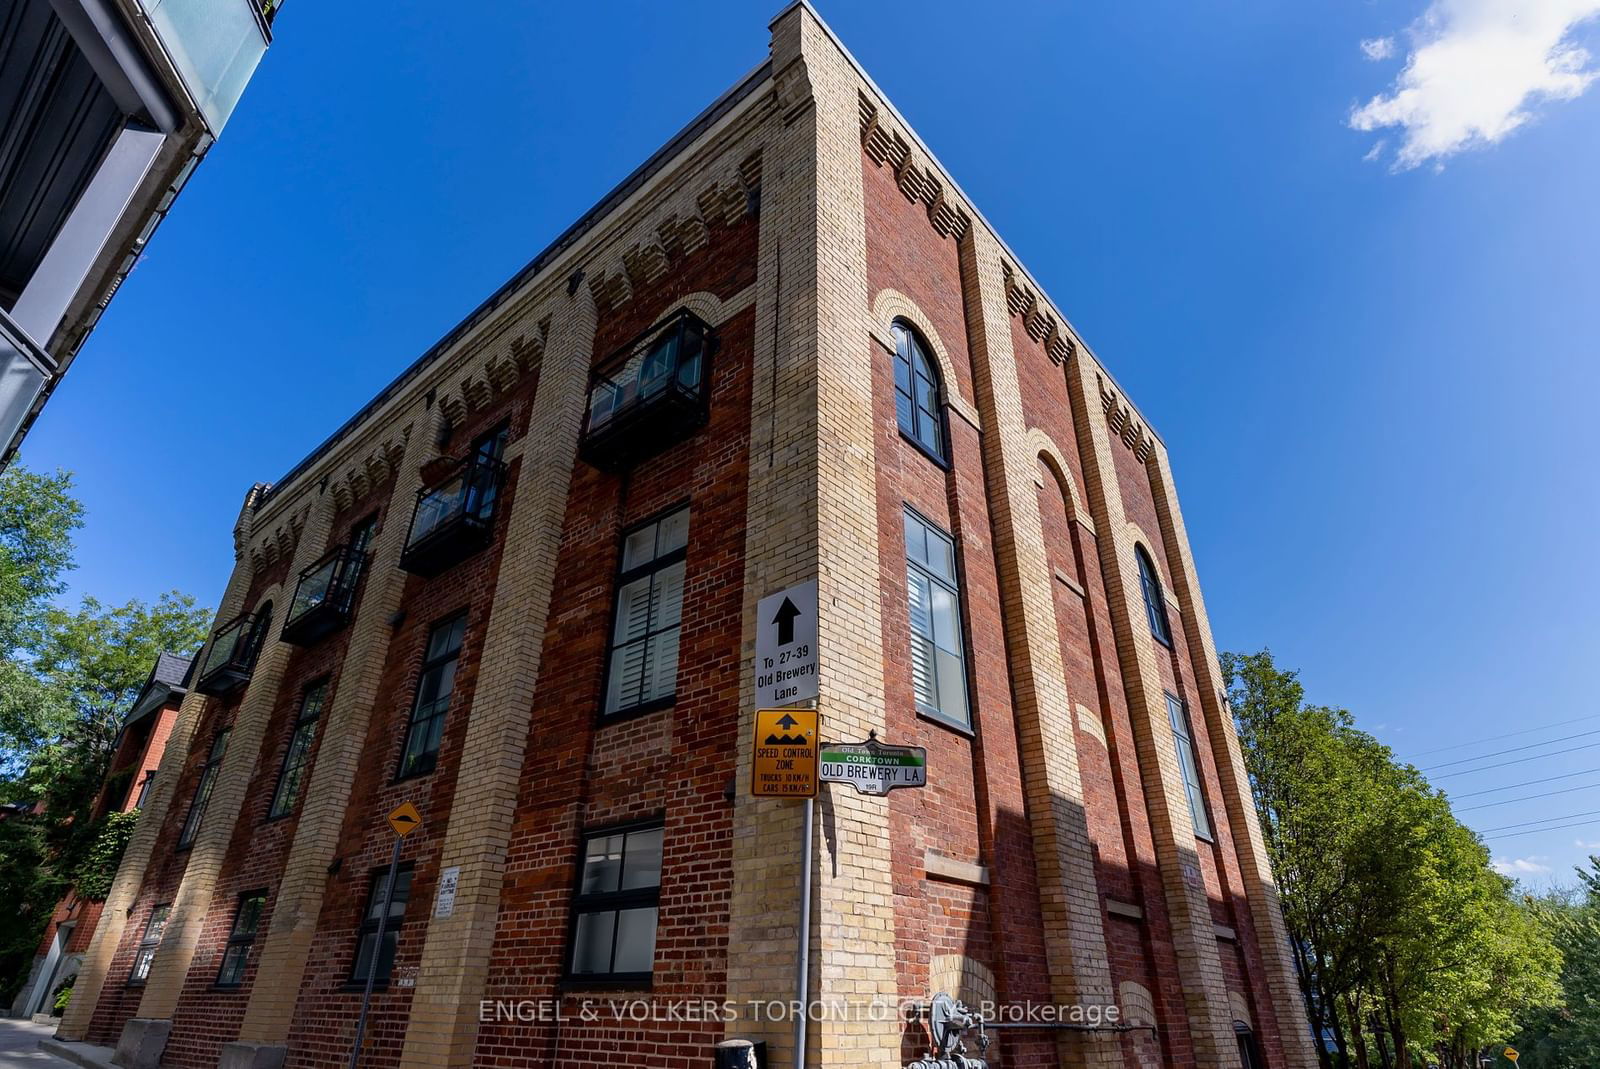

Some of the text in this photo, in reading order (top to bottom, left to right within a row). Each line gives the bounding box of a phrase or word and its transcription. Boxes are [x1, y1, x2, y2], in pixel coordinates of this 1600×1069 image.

[763, 645, 809, 669] To 27-39
[757, 662, 816, 688] Old Brewery
[774, 686, 798, 701] Lane
[757, 748, 814, 758] SPEED CONTROL
[776, 760, 794, 770] ZONE
[846, 755, 900, 765] CORKTOWN
[760, 773, 782, 782] TRUCKS
[822, 763, 922, 782] OLD BREWERY LA.
[763, 783, 779, 792] CARS
